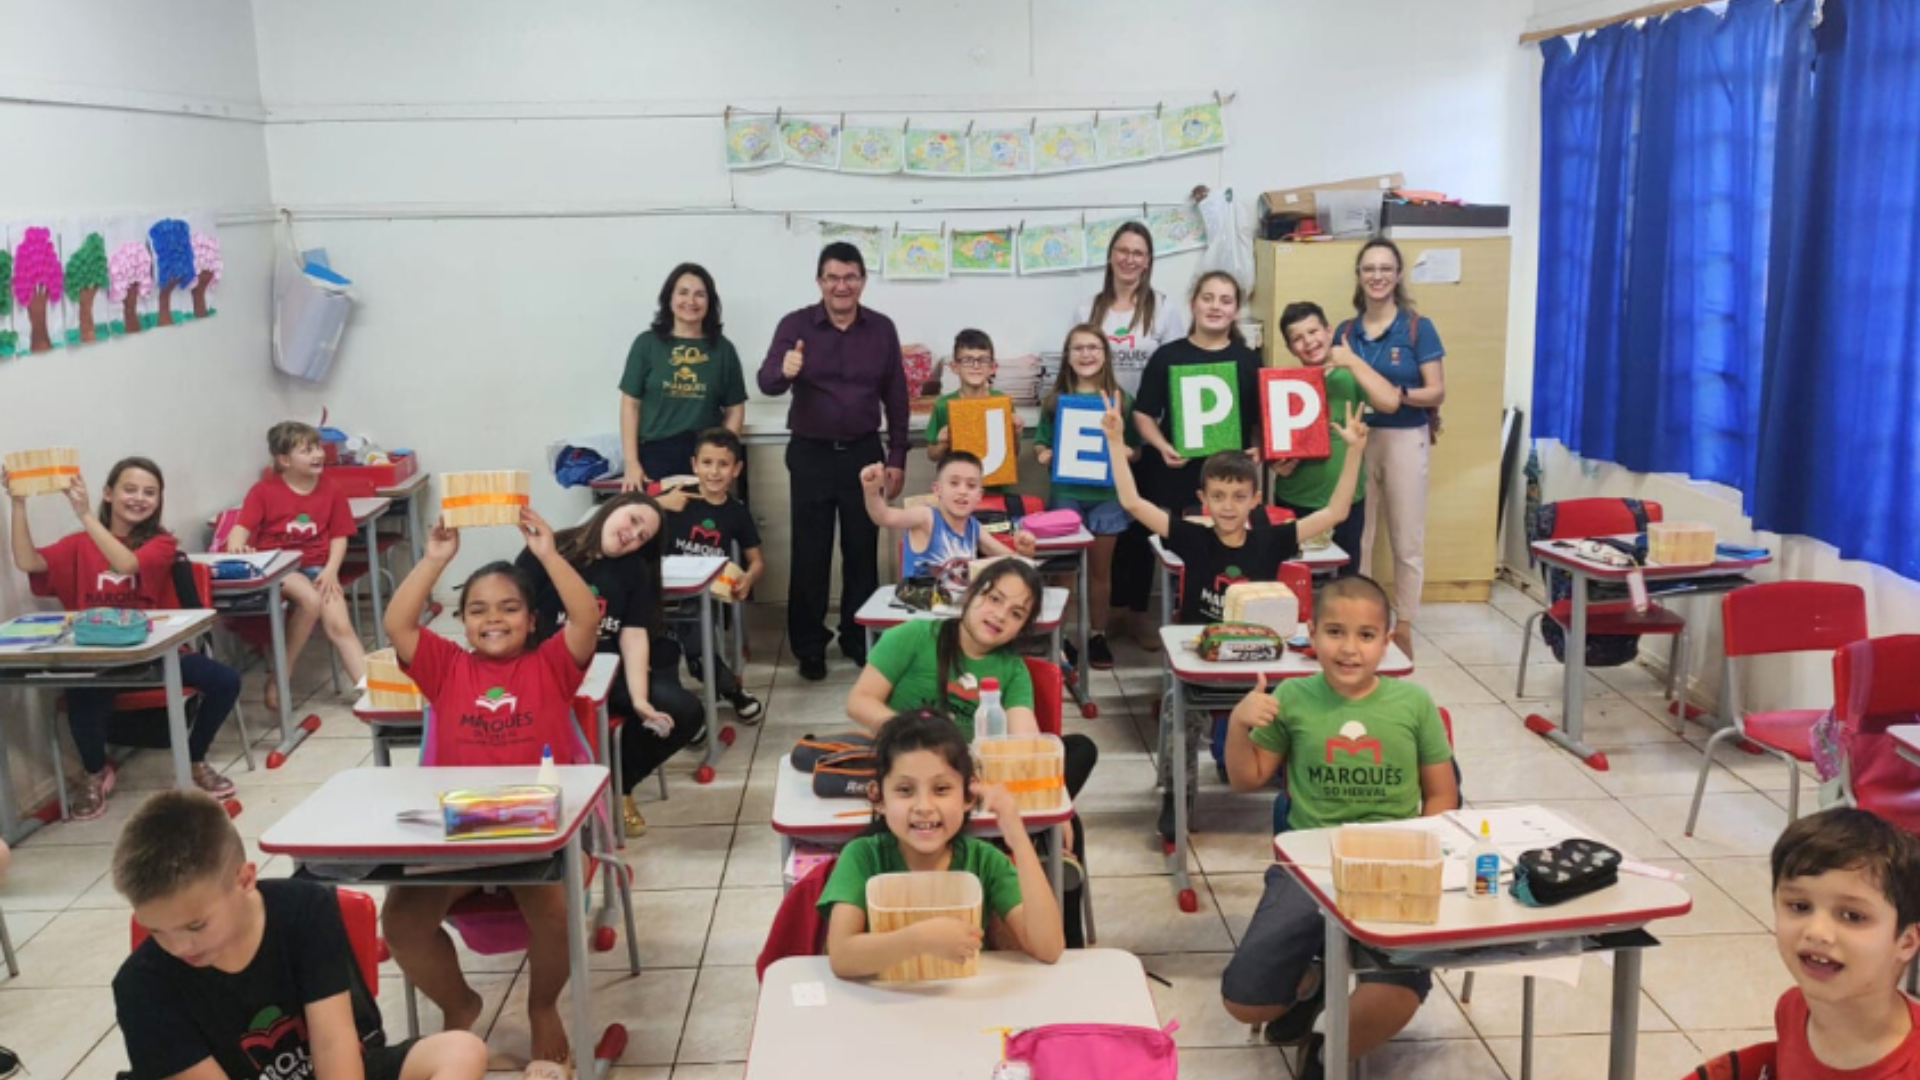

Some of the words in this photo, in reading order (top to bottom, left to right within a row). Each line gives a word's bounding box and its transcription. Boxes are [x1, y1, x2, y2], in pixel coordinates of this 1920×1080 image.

[1057, 408, 1107, 480] E
[1179, 374, 1233, 448] P
[1267, 379, 1321, 452] P
[1307, 763, 1402, 786] MARQUÊS
